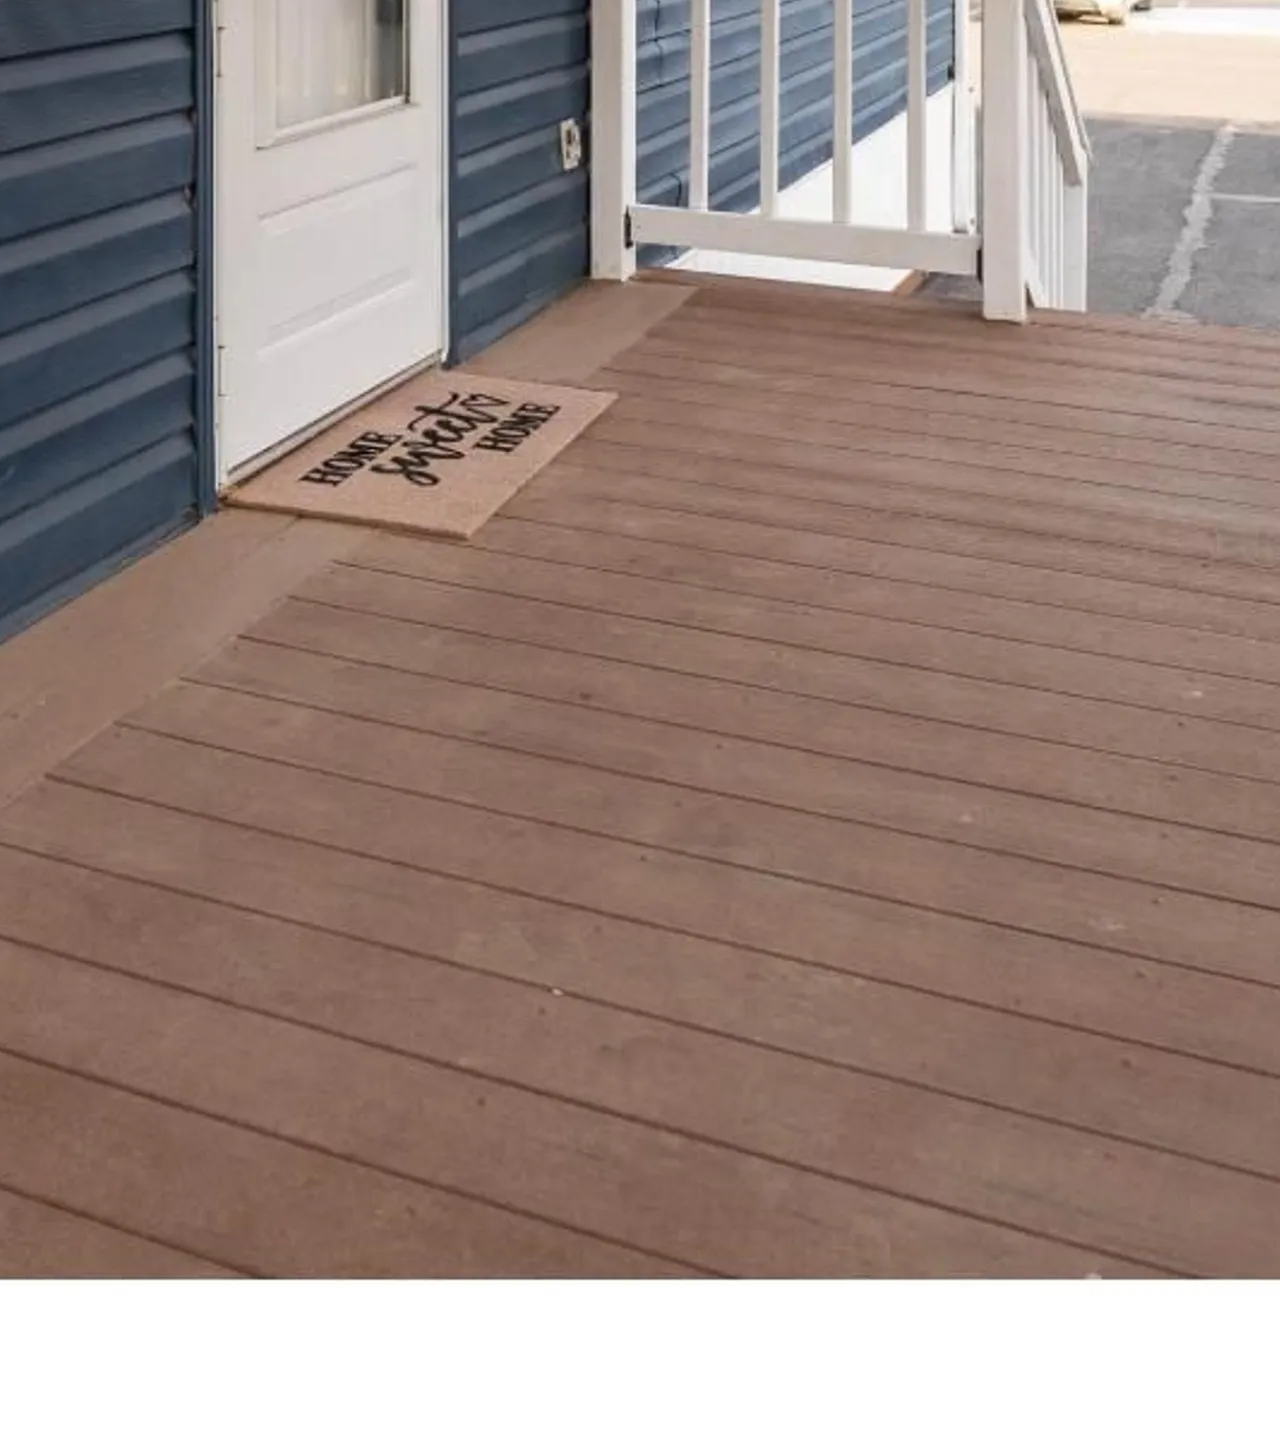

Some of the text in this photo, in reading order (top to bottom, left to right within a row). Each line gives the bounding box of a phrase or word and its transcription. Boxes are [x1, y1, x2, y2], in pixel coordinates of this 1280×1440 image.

[368, 391, 510, 487] sweet
[473, 402, 562, 454] HOME
[298, 430, 405, 487] HOME
